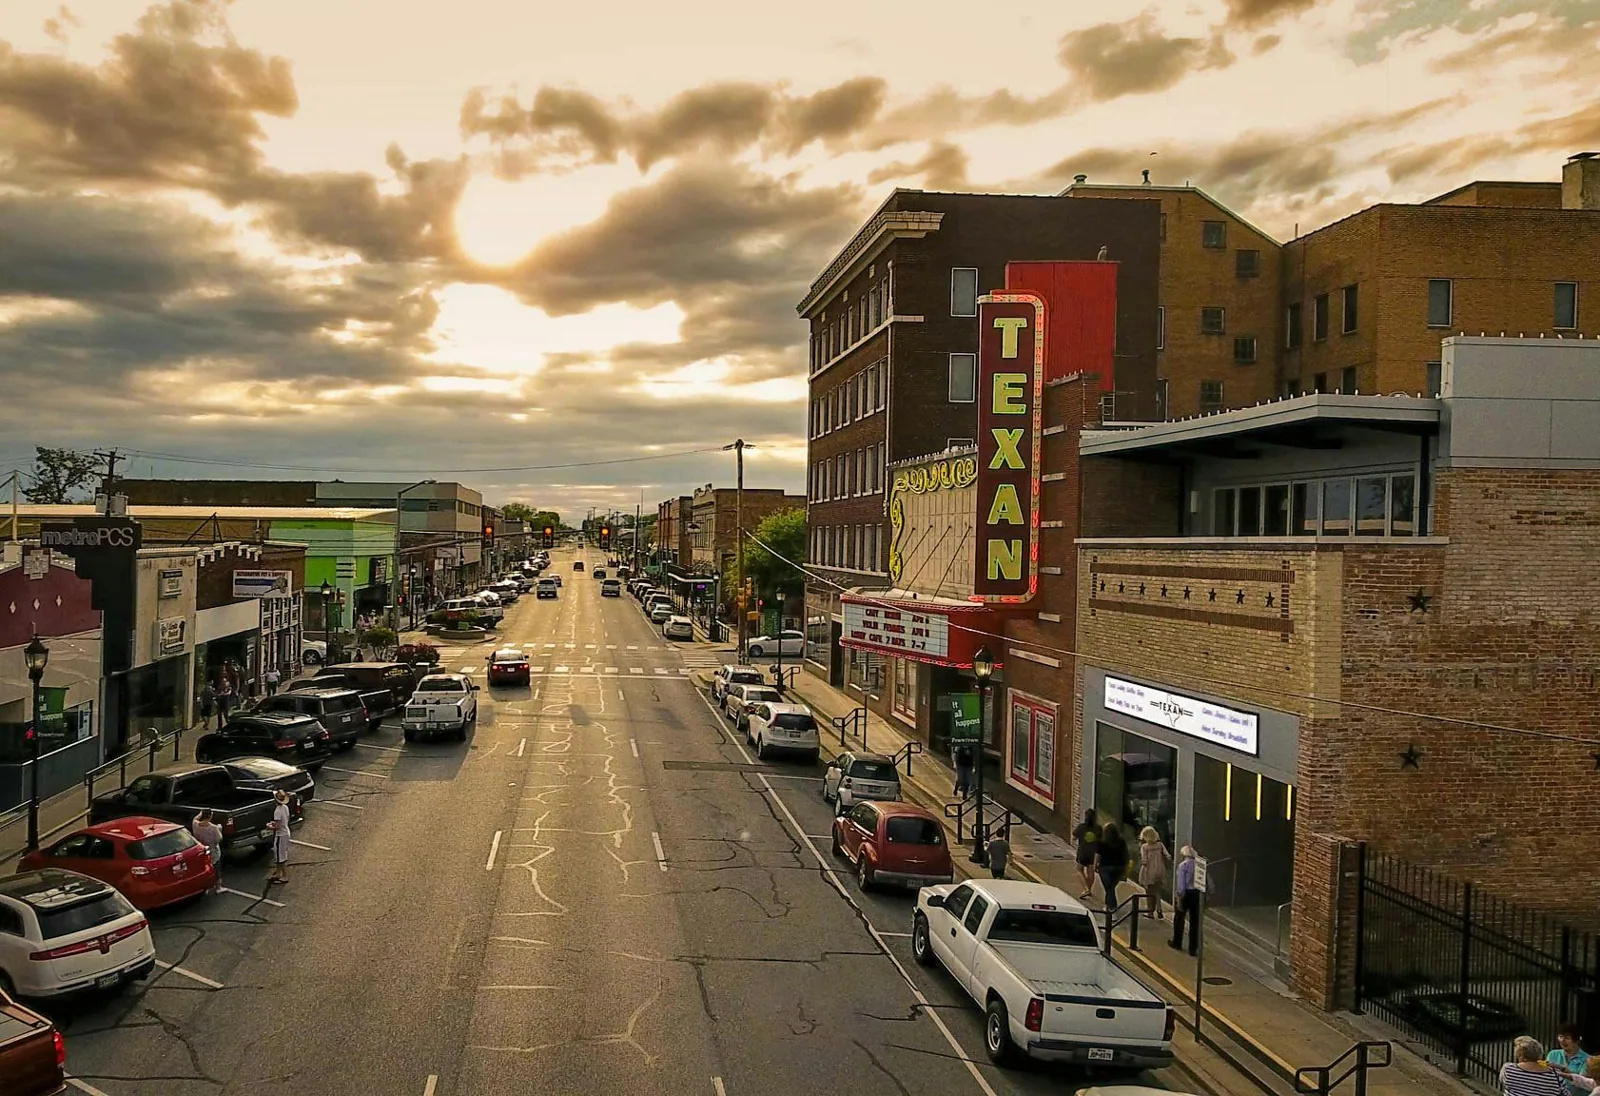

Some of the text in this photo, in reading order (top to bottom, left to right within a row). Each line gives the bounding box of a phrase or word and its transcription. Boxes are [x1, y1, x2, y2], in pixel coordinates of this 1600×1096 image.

[987, 317, 1028, 581] TEXAN
[41, 527, 134, 546] metroPCS
[911, 639, 926, 650] 7-7
[951, 701, 958, 709] It
[1158, 701, 1184, 716] TEXAN
[954, 709, 963, 718] all
